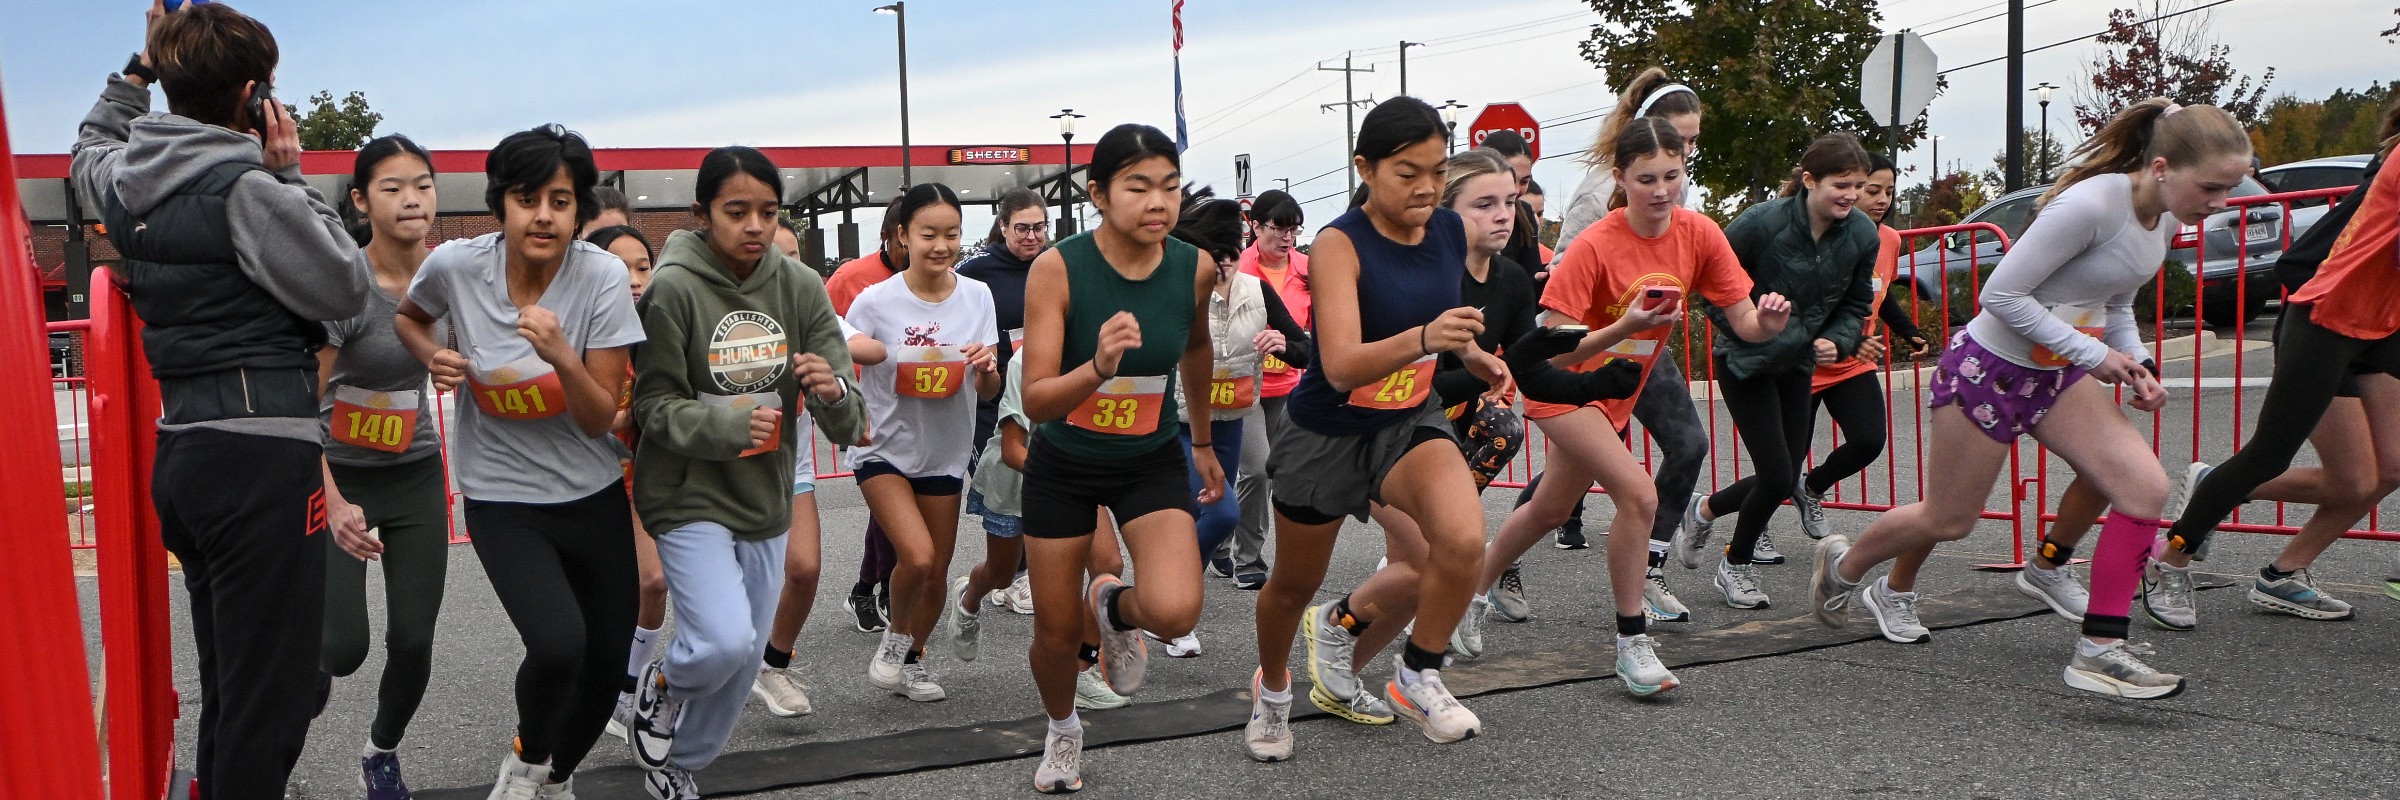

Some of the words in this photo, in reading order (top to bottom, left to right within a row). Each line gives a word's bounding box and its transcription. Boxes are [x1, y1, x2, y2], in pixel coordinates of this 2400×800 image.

[966, 150, 1017, 159] SHEETZ
[717, 313, 775, 336] ESTABLISHED
[719, 342, 778, 365] HURLEY
[720, 379, 747, 393] SINCE
[915, 366, 949, 393] 52
[1374, 369, 1417, 402] 25
[484, 384, 547, 414] 141
[1092, 398, 1139, 429] 33
[347, 411, 404, 446] 140
